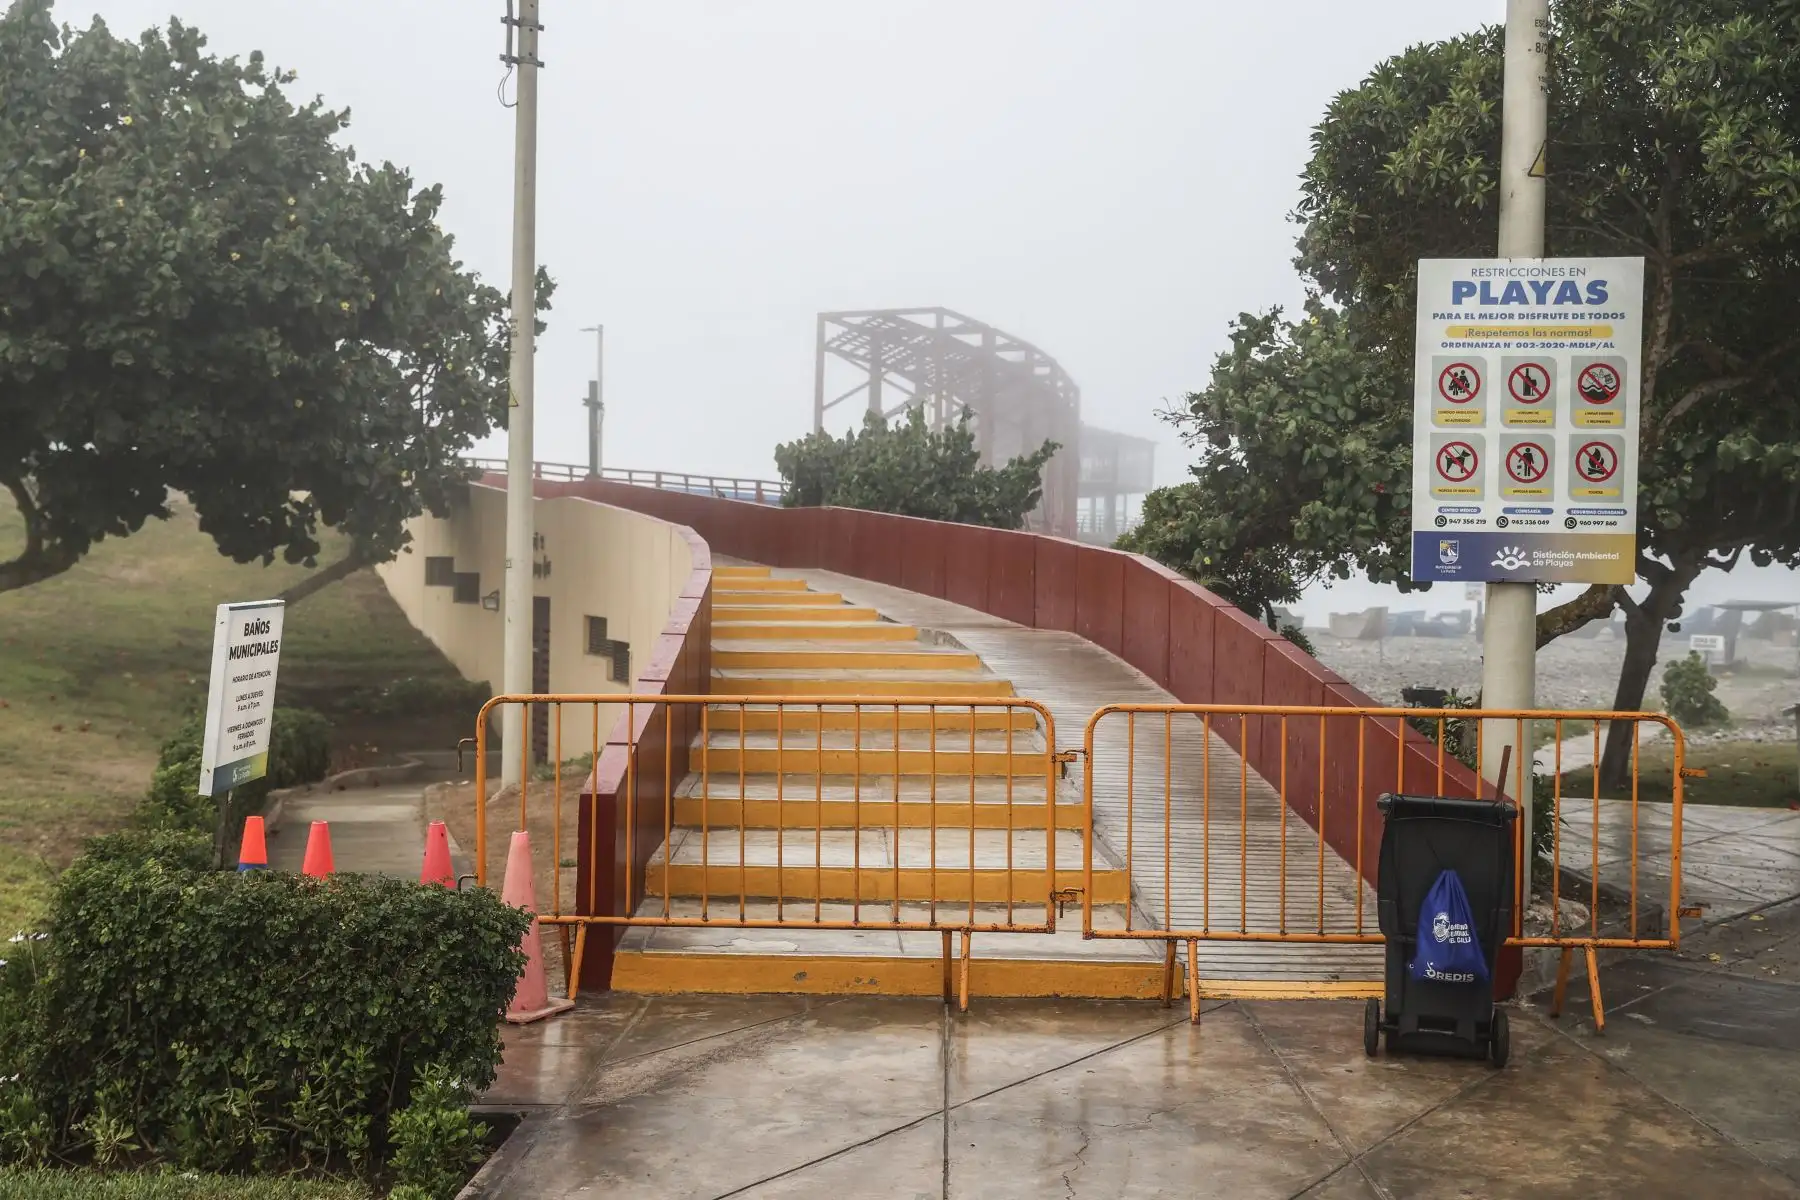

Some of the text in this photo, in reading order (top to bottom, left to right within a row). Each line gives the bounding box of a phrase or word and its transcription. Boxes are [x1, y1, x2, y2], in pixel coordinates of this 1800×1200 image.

[1471, 267, 1587, 277] RESTRICCIONES EN
[1452, 280, 1610, 306] PLAYAS
[1432, 312, 1626, 320] PARA EL MEJOR DISFRUTE DE TODOS
[1465, 328, 1592, 339] ¡Respetemos las normas!
[1532, 550, 1620, 560] Distinción Ambiental
[1545, 559, 1574, 567] Playas
[244, 617, 271, 636] BAÑOS
[229, 640, 279, 660] MUNICIPALES
